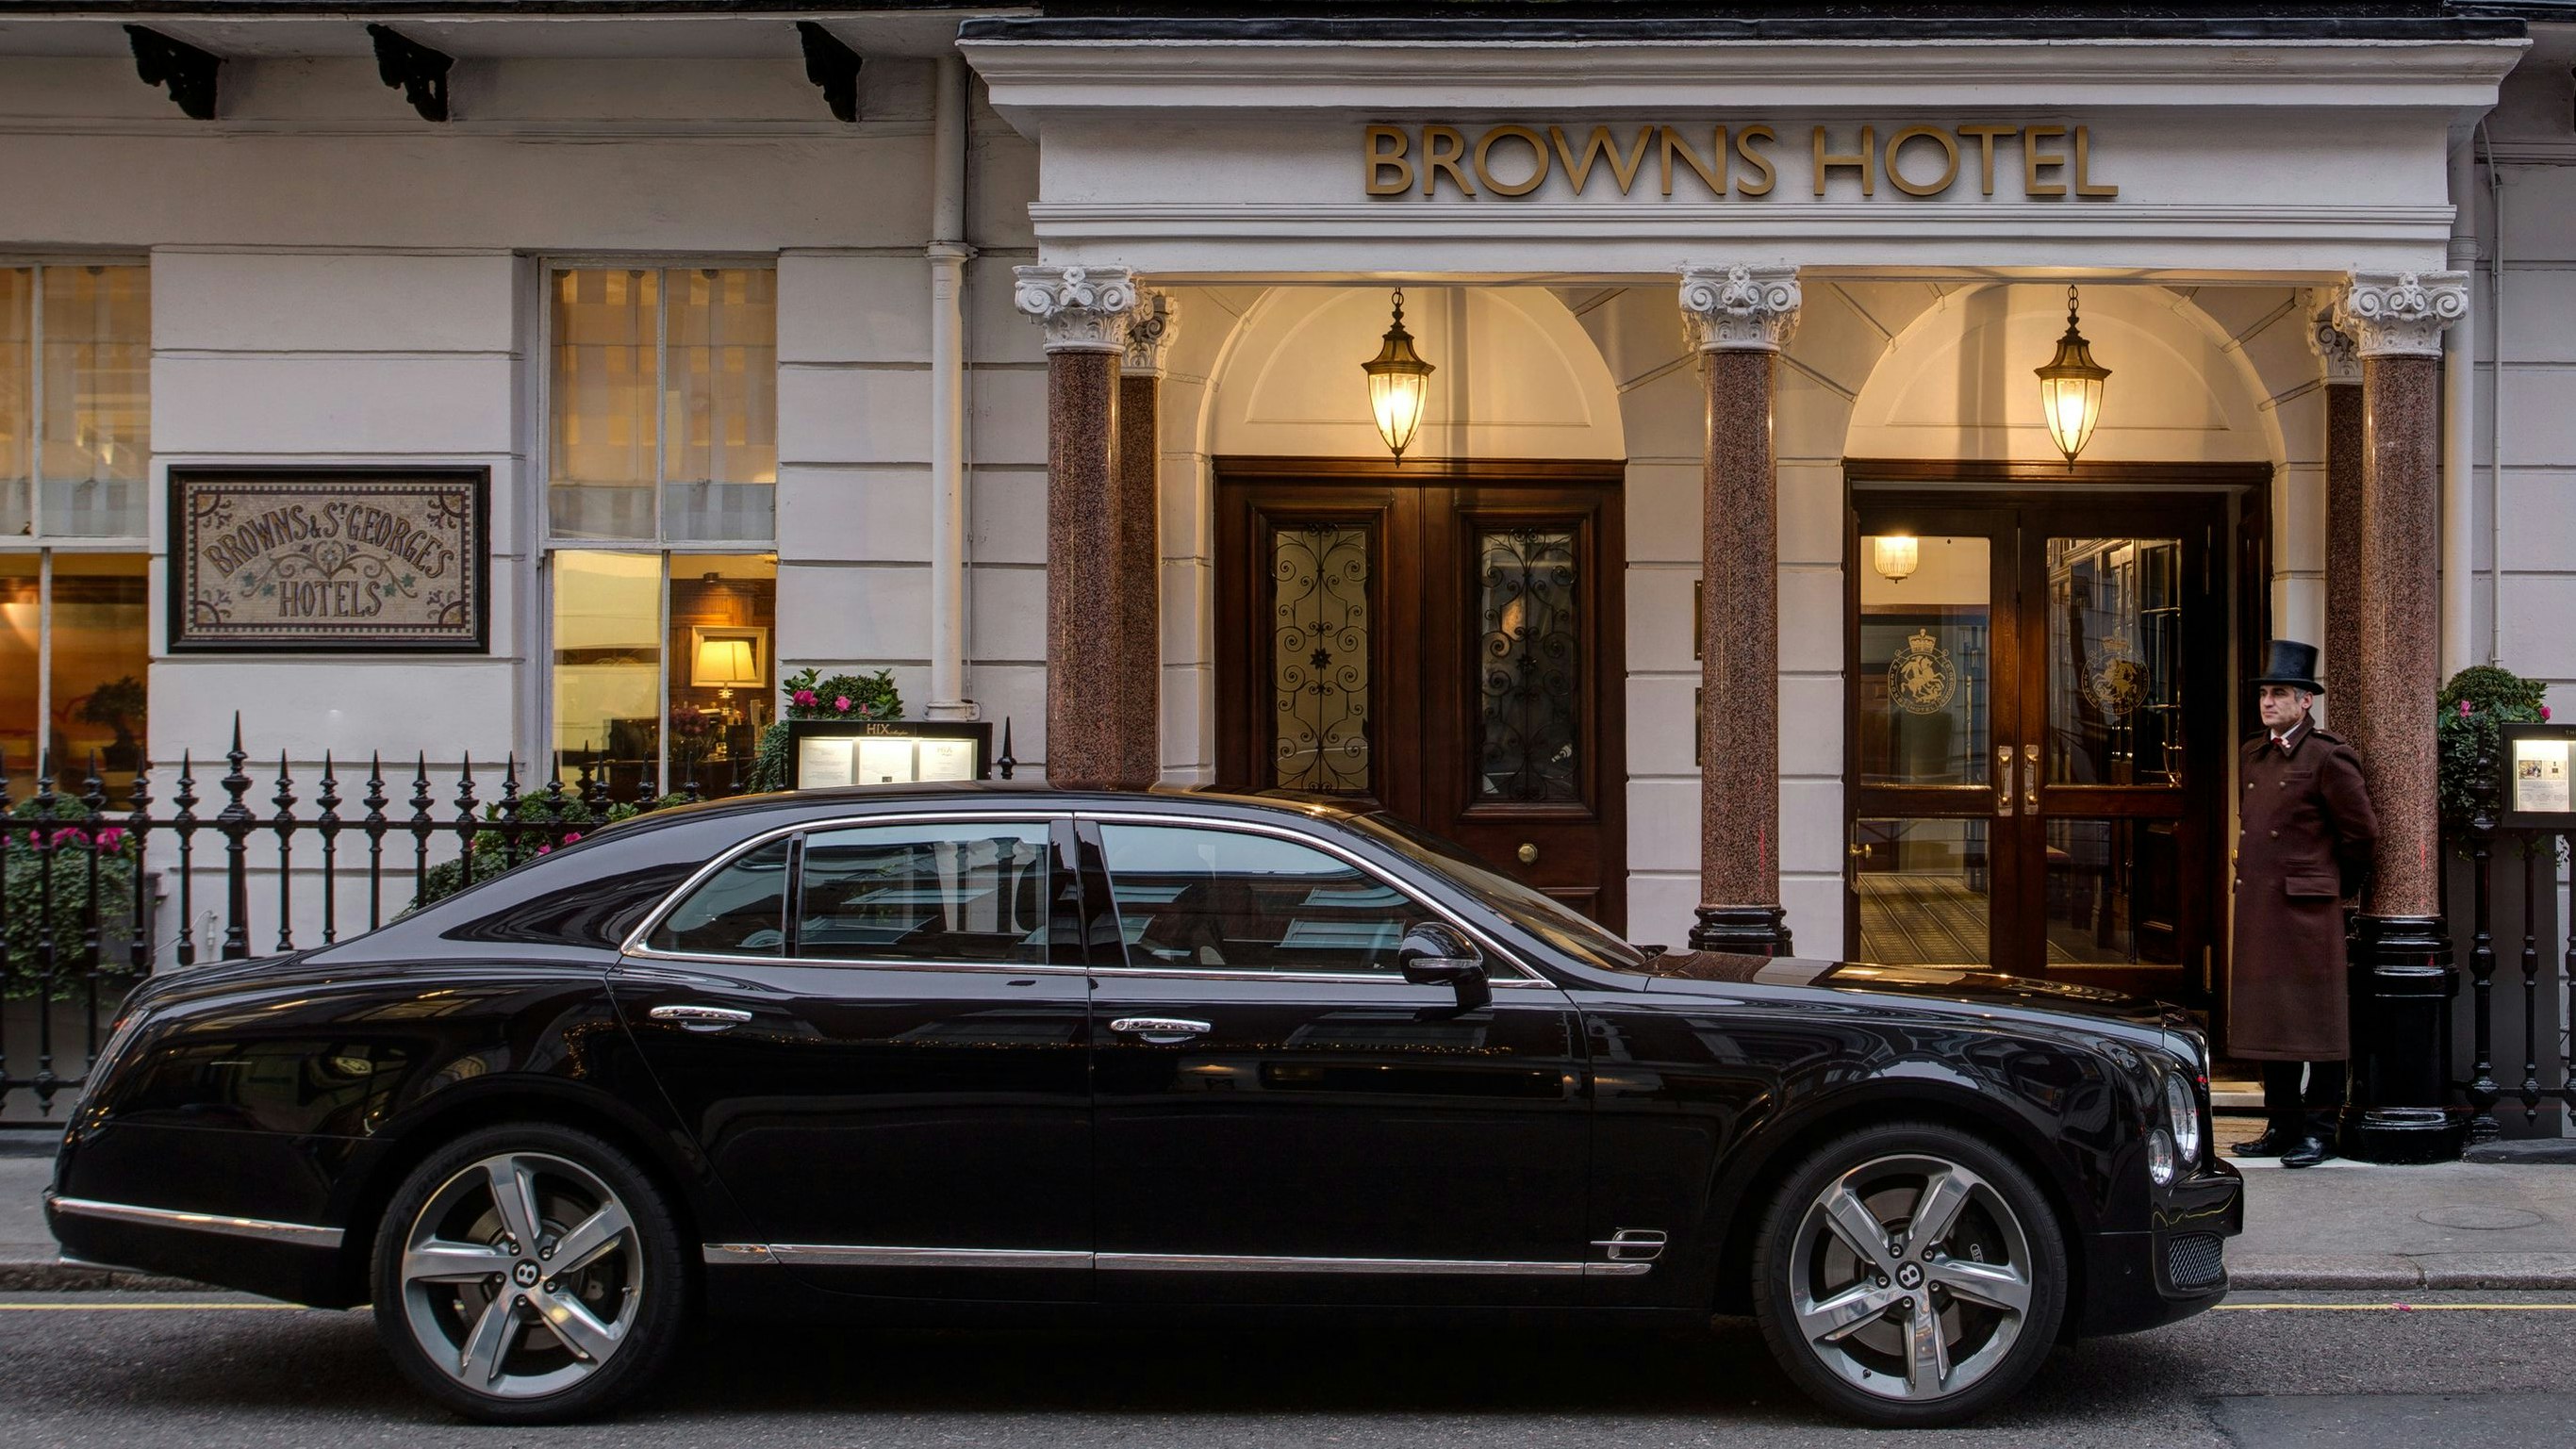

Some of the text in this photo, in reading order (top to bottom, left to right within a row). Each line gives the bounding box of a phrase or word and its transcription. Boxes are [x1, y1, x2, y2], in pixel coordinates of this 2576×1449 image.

[1365, 124, 2120, 196] BROWNS HOTEL
[203, 504, 309, 579] BROWNS
[308, 515, 322, 538] &
[345, 503, 454, 579] GEORGES
[278, 581, 382, 617] HOTELS
[867, 723, 890, 734] HIX
[517, 1264, 537, 1285] B
[1900, 1263, 1921, 1287] B
